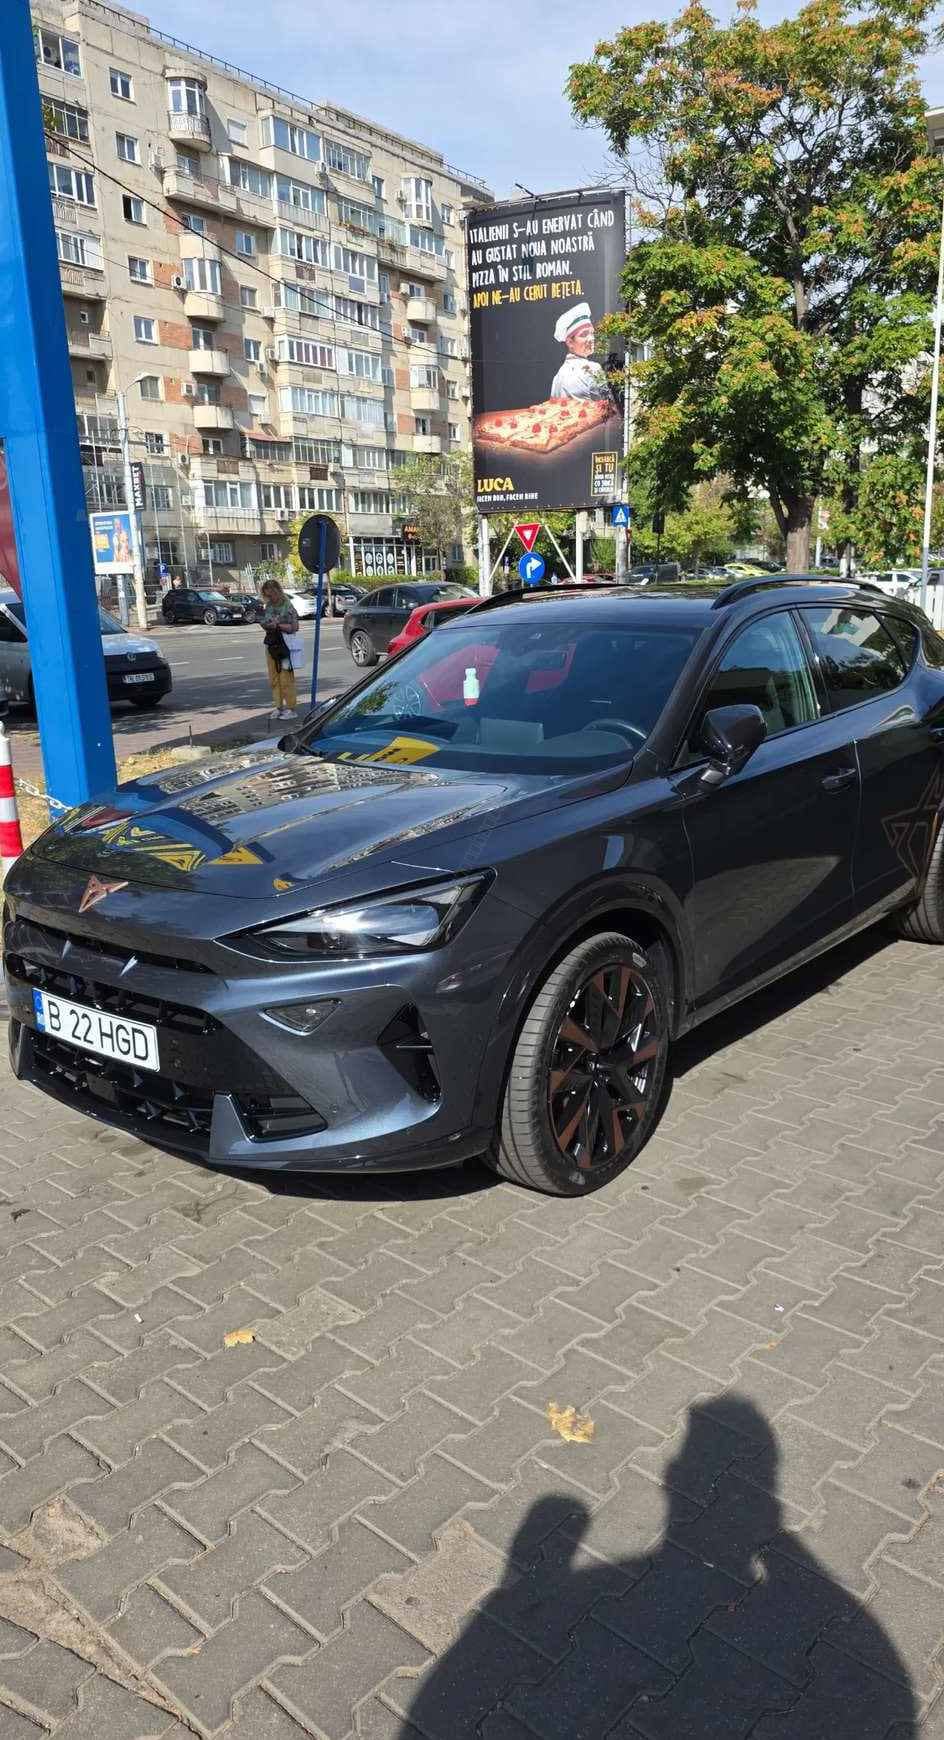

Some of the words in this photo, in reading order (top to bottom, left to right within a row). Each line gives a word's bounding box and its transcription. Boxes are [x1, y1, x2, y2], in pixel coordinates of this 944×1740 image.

[470, 224, 509, 244] ITALIENII
[512, 219, 539, 238] S-AU
[542, 214, 583, 234] ENERVAT
[587, 208, 615, 229] CÂND
[471, 249, 482, 266] AU
[486, 244, 517, 263] GUSTAT
[521, 240, 547, 258] NOUA
[550, 232, 595, 255] NOASTRĂ
[472, 268, 496, 288] PIZZA
[498, 265, 509, 283] ÎN
[512, 264, 532, 282] STIL
[536, 260, 573, 279] ROMAN.
[473, 291, 489, 309] APOI
[492, 286, 520, 306] NE-AU
[524, 283, 548, 301] CERUT
[477, 477, 515, 493] LUCA
[48, 1000, 61, 1031] B
[70, 1009, 94, 1045] 22
[98, 1017, 149, 1061] HGD
